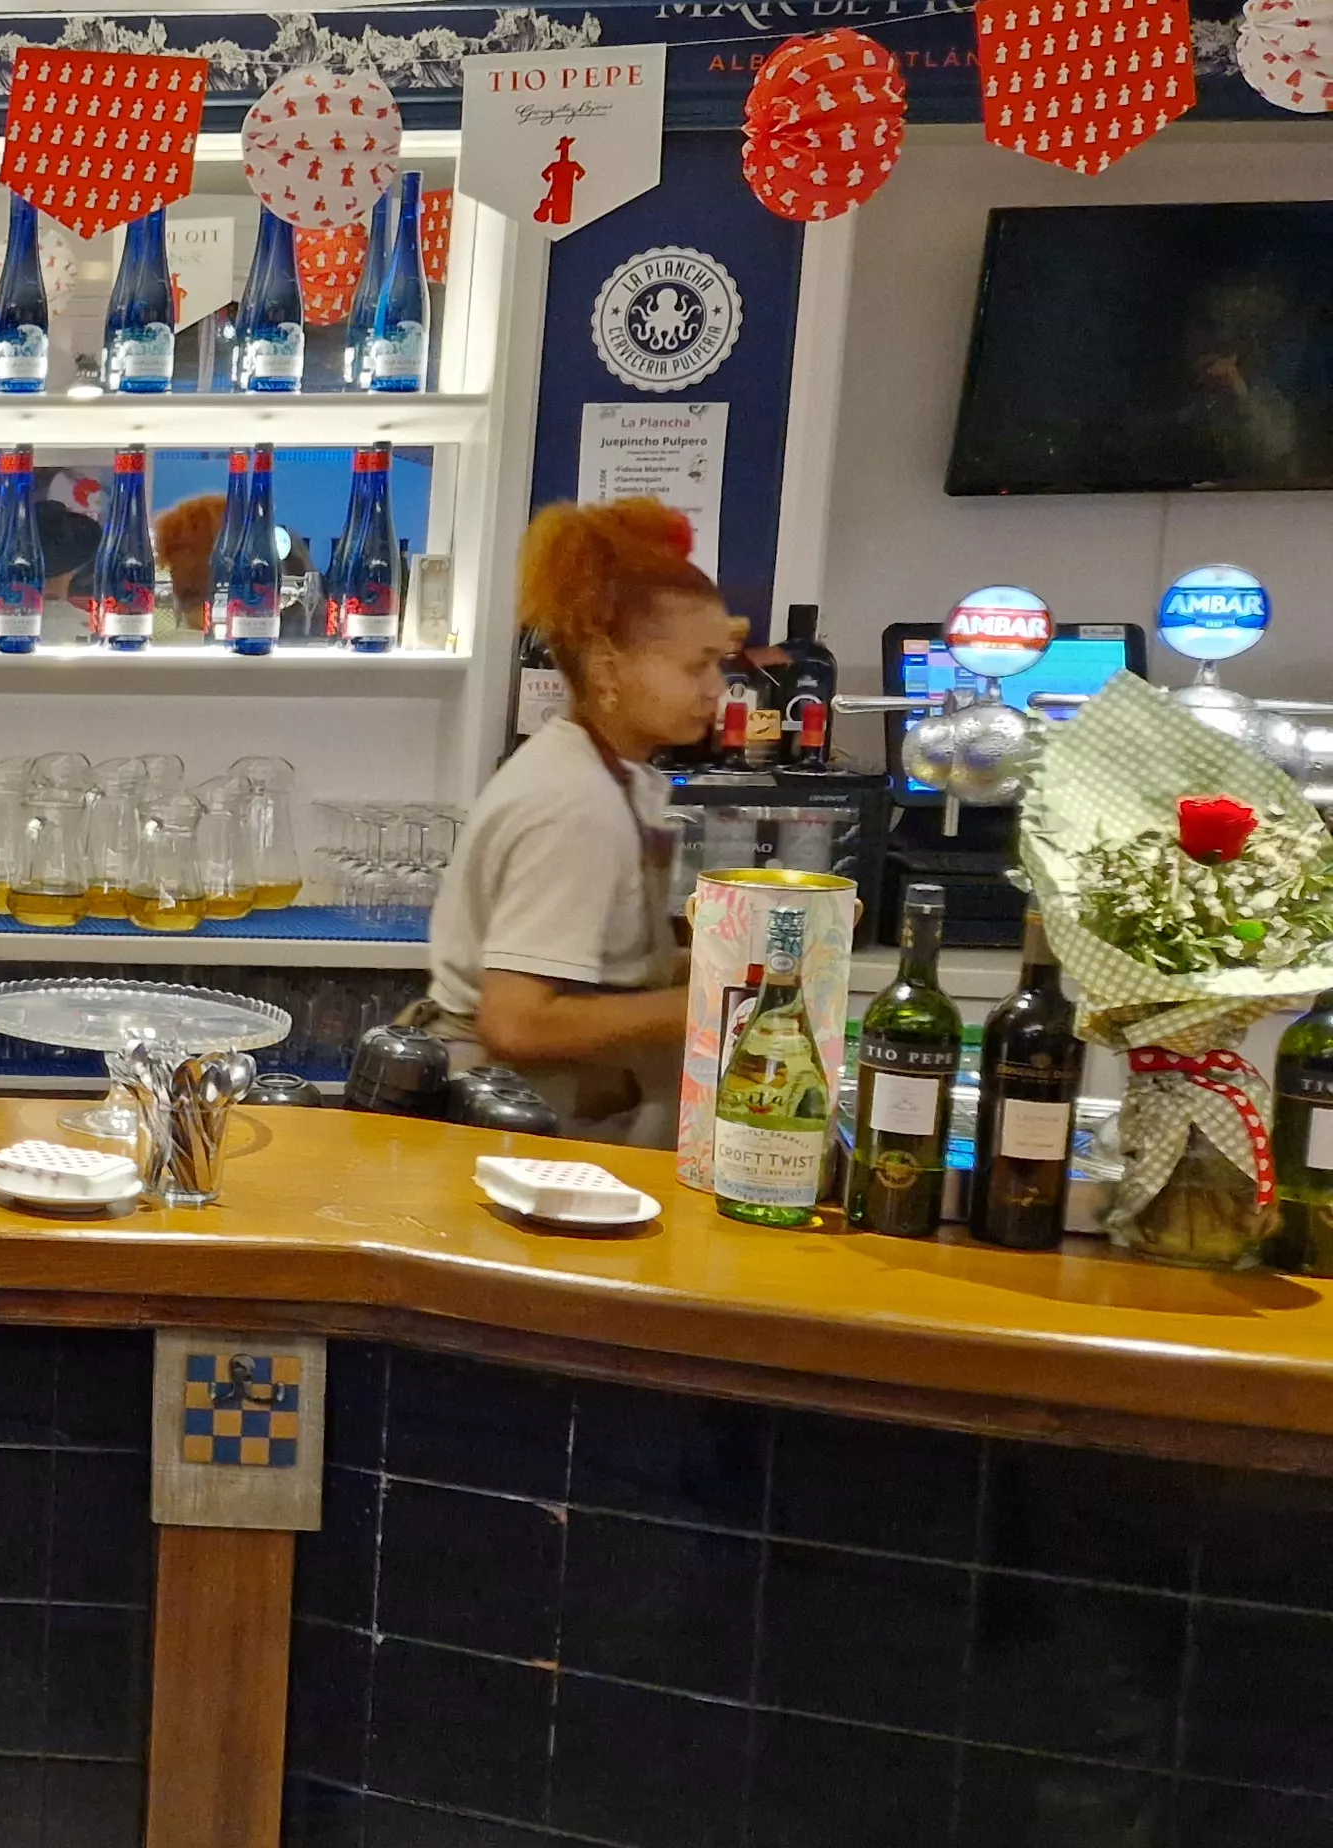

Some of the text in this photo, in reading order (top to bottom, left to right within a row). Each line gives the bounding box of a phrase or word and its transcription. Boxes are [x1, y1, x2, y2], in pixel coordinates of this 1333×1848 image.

[487, 64, 645, 93] TIO PEPE
[621, 260, 716, 294] LA PLANCHA
[607, 325, 724, 376] CERVECERIA PULPERIA
[621, 417, 691, 429] La Plancha
[600, 436, 708, 449] Juepincho Pulpero
[1166, 593, 1264, 617] AMBAR
[951, 614, 1050, 640] AMBAR
[526, 680, 566, 692] VERM
[865, 1044, 954, 1066] TIO PEPE
[718, 1143, 764, 1165] CROFT
[768, 1152, 816, 1169] TWIST
